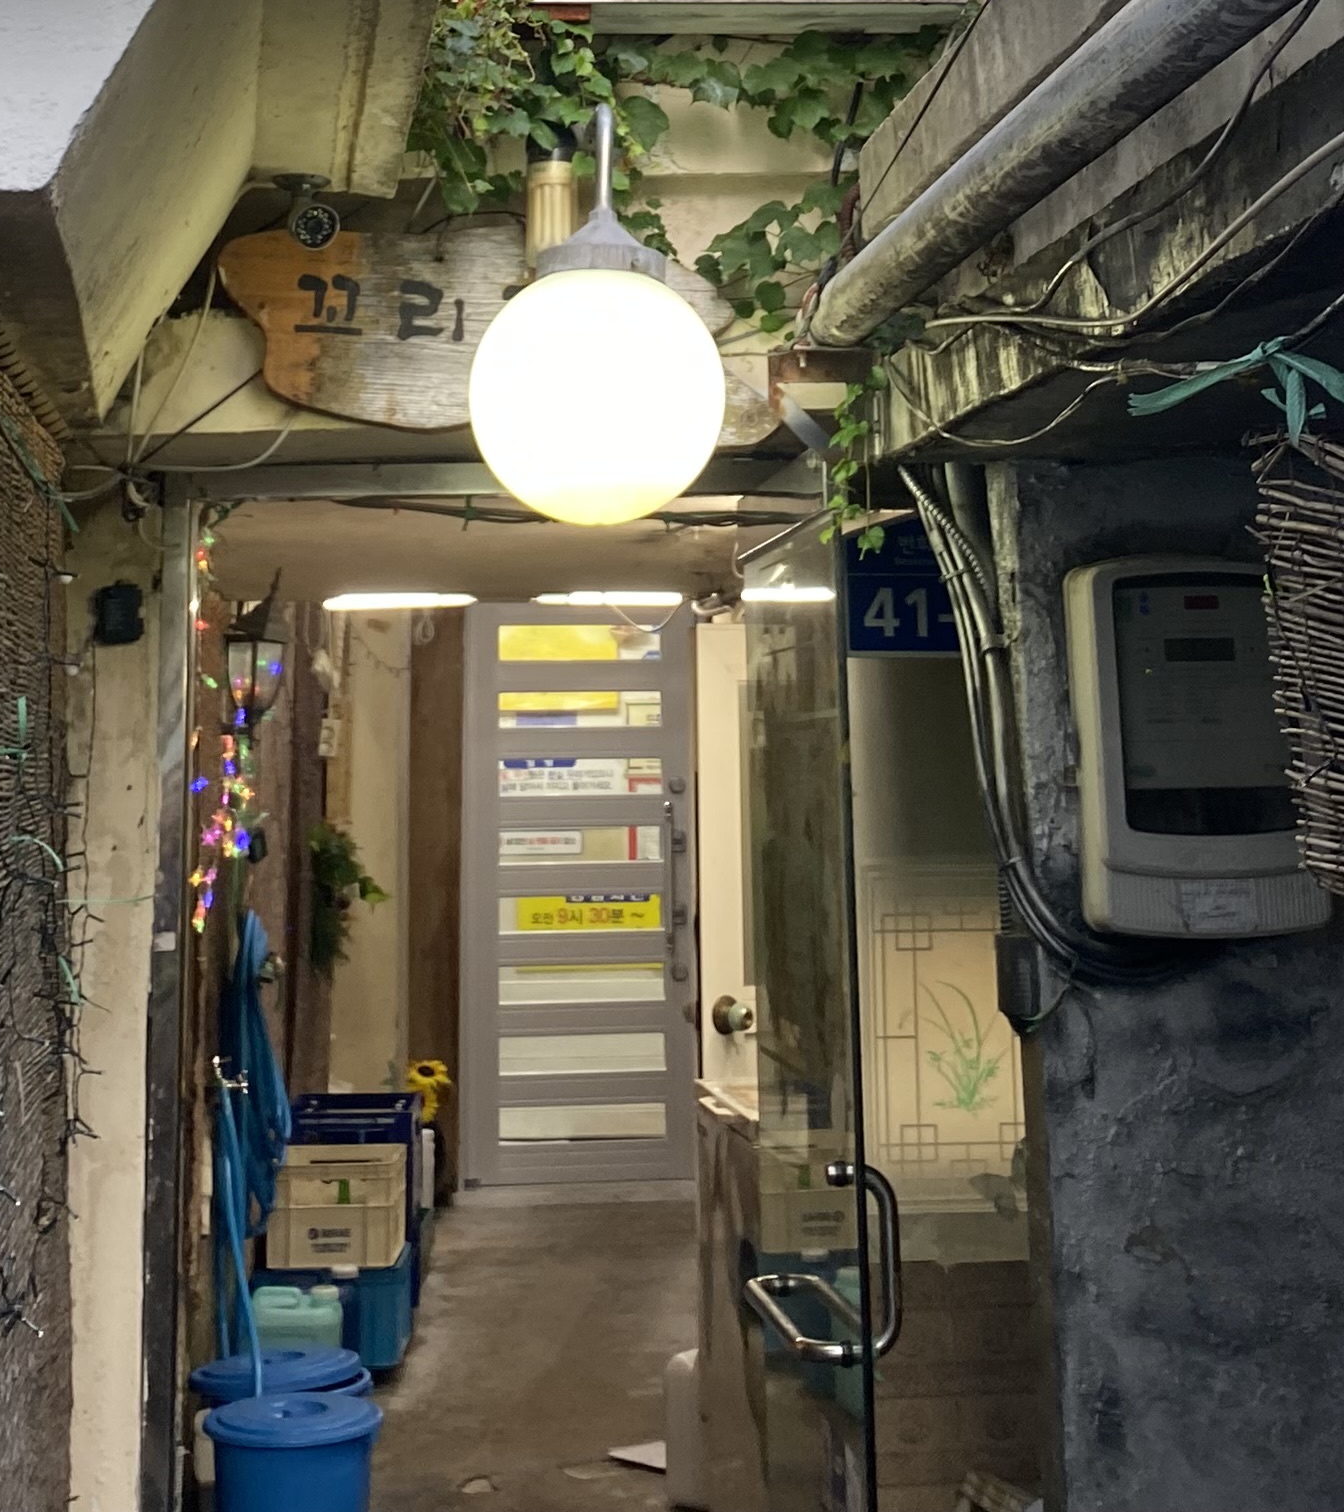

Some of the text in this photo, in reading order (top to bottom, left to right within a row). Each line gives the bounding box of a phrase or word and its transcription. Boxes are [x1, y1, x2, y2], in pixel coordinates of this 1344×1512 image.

[295, 273, 532, 342] 꼬리
[557, 908, 583, 925] 9시
[589, 907, 624, 924] 30분
